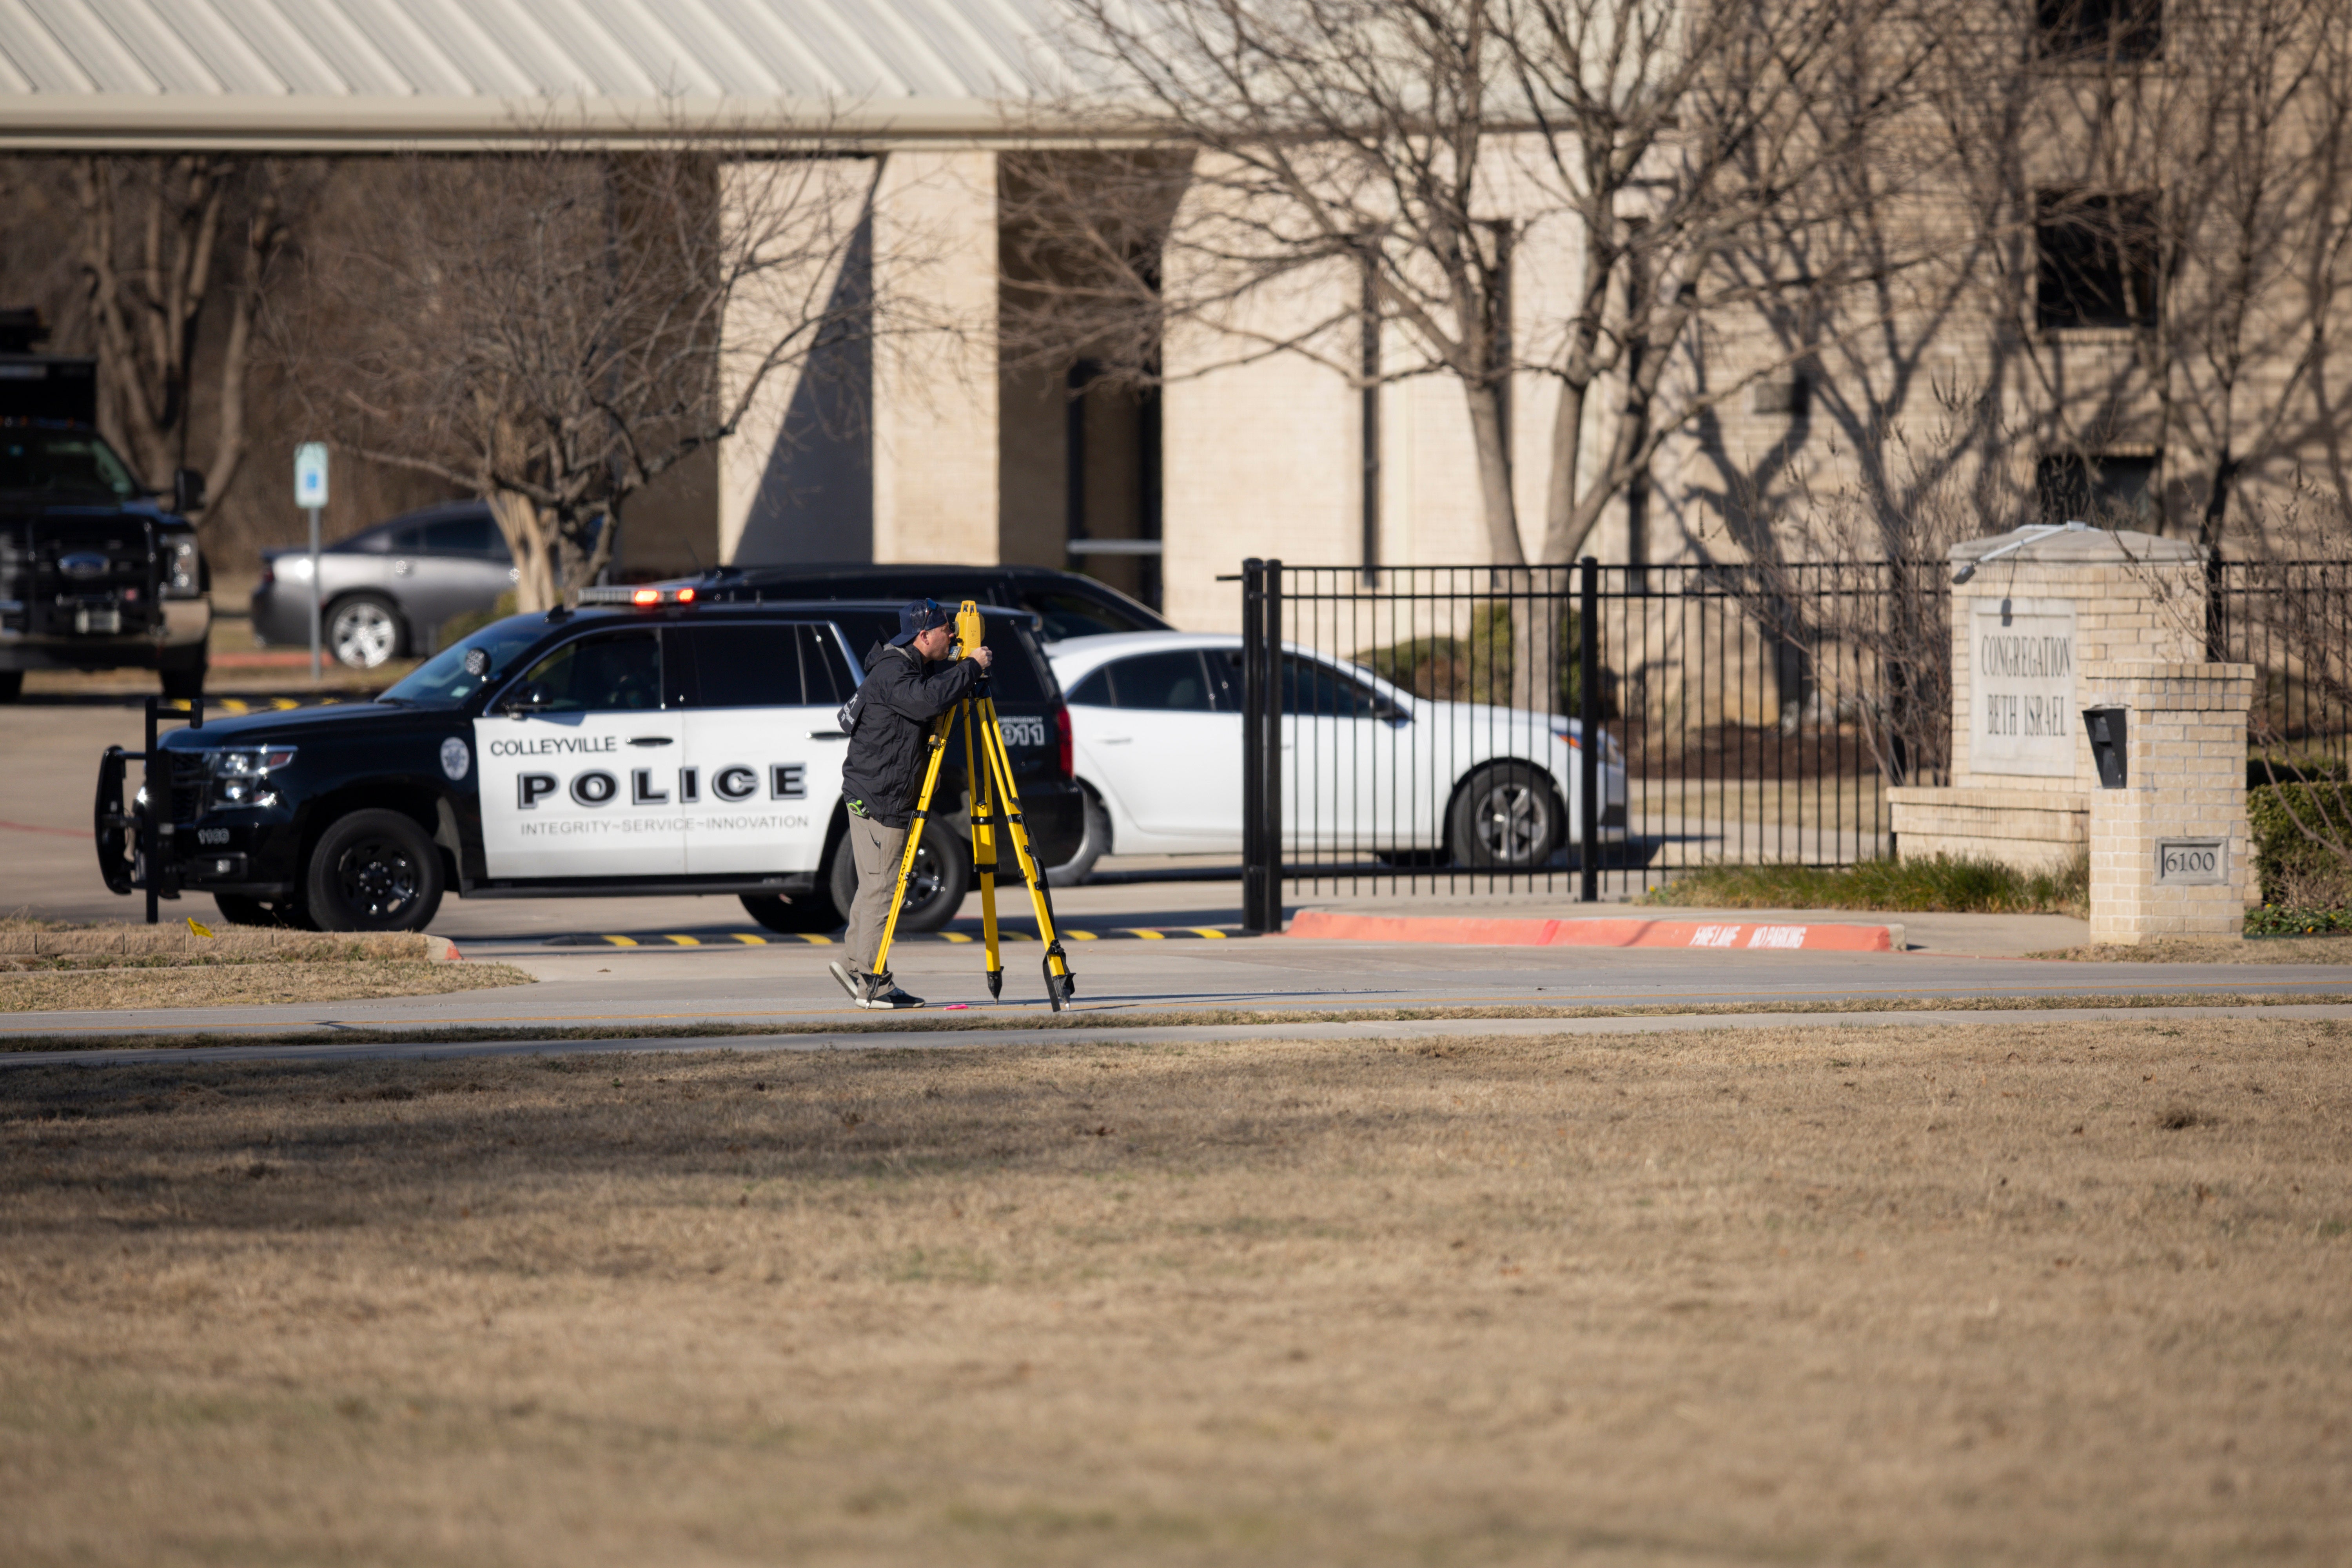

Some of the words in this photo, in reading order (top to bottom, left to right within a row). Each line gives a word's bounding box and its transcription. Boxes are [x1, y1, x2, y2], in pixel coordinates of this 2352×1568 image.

[1981, 634, 2071, 677] CONGREGATION
[1987, 694, 2017, 736] BETH
[2024, 695, 2067, 737] ISRAEL
[490, 736, 617, 757] COLLEYVILLE
[1000, 723, 1045, 746] 911
[517, 762, 808, 809] POLICE
[2165, 852, 2215, 872] 6100
